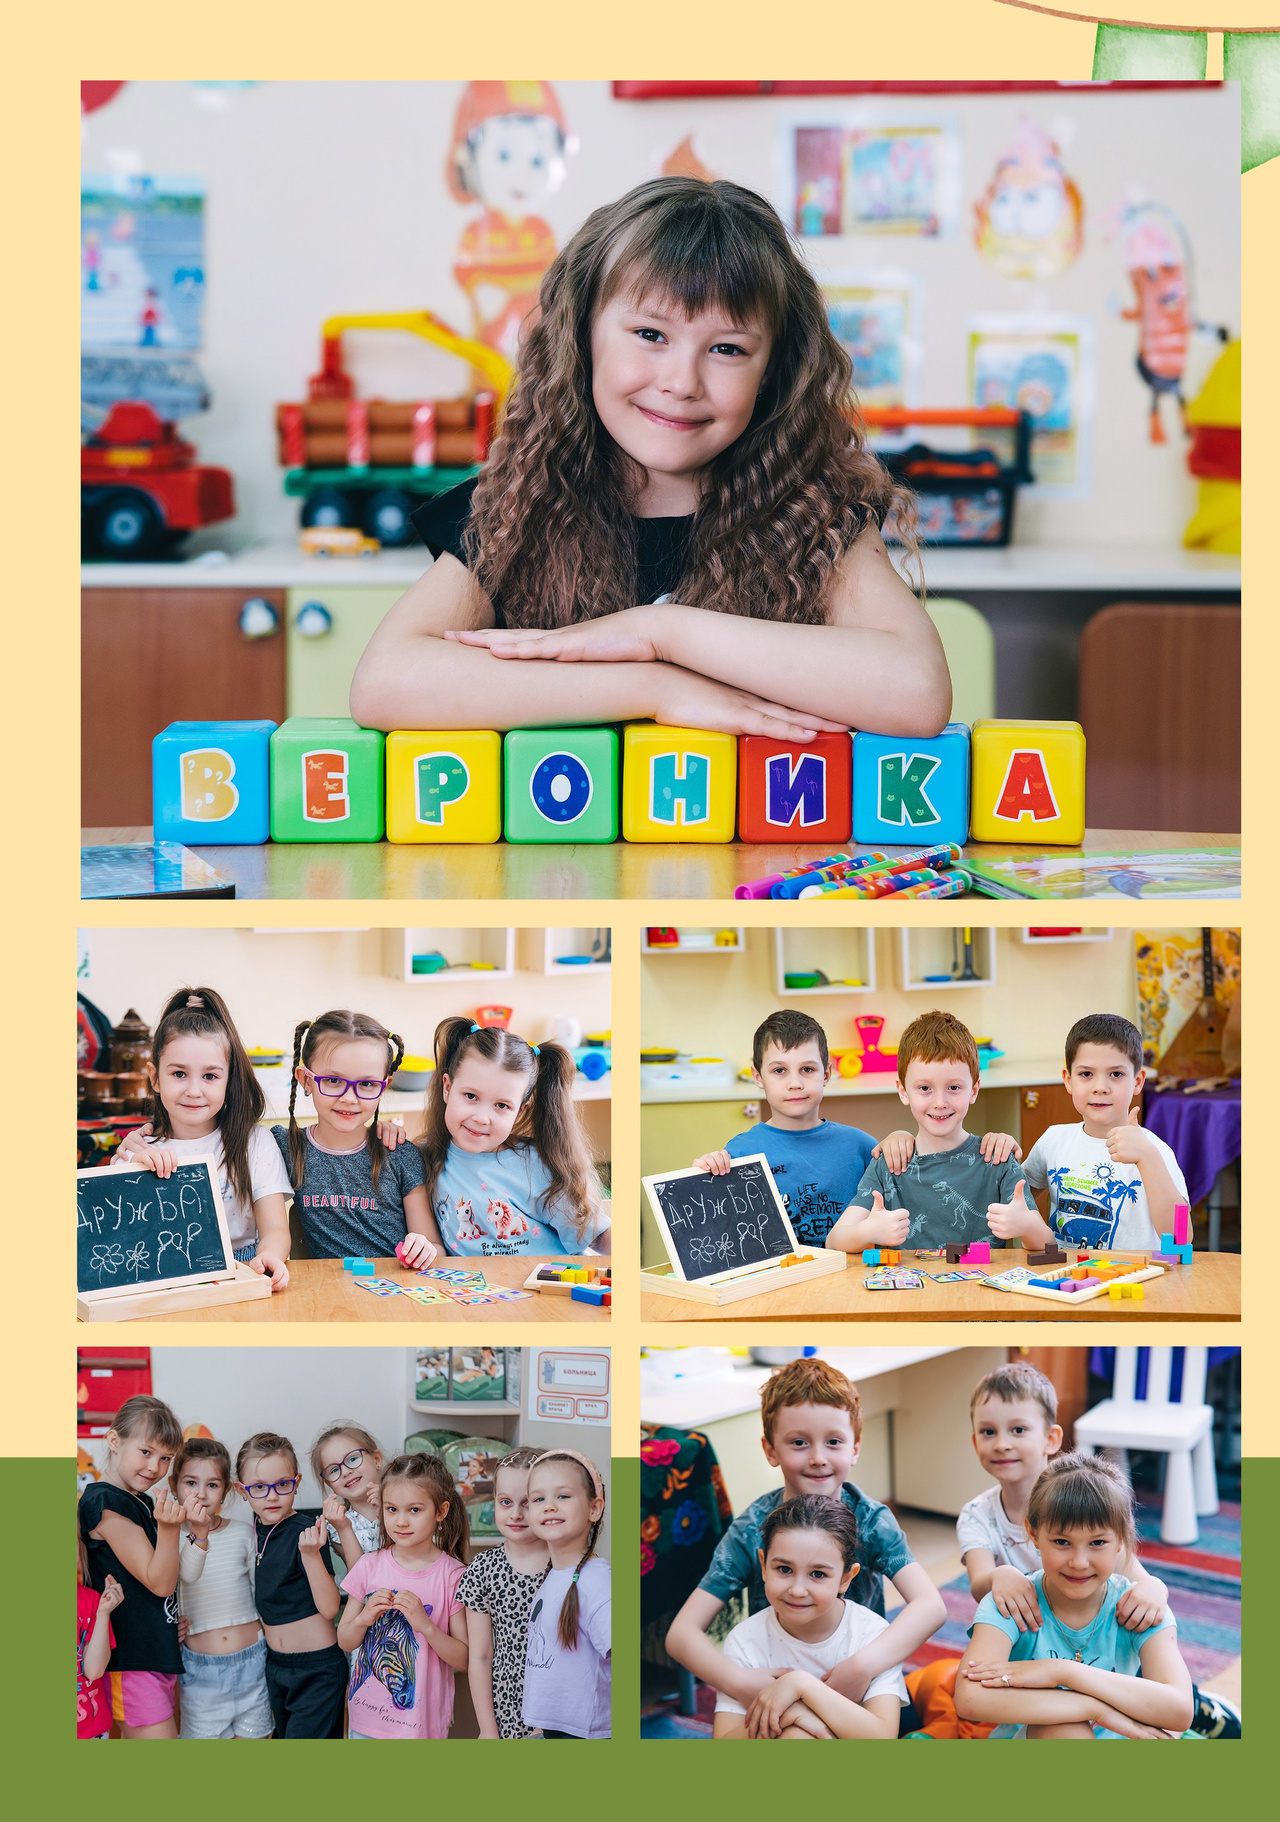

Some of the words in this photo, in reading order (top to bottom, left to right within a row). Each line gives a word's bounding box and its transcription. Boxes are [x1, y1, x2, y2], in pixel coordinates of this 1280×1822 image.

[797, 1182, 819, 1196] LIFE
[303, 1194, 379, 1211] BEAUTIFUL
[793, 1194, 813, 1207] HAS
[817, 1192, 829, 1203] NO
[801, 1200, 845, 1217] REMOTE
[481, 1242, 490, 1250] Be
[492, 1242, 512, 1251] always
[494, 1248, 519, 1256] miracles
[563, 1369, 597, 1377] БОЛЬНИЦА
[361, 1699, 378, 1712] happy
[378, 1704, 389, 1715] for
